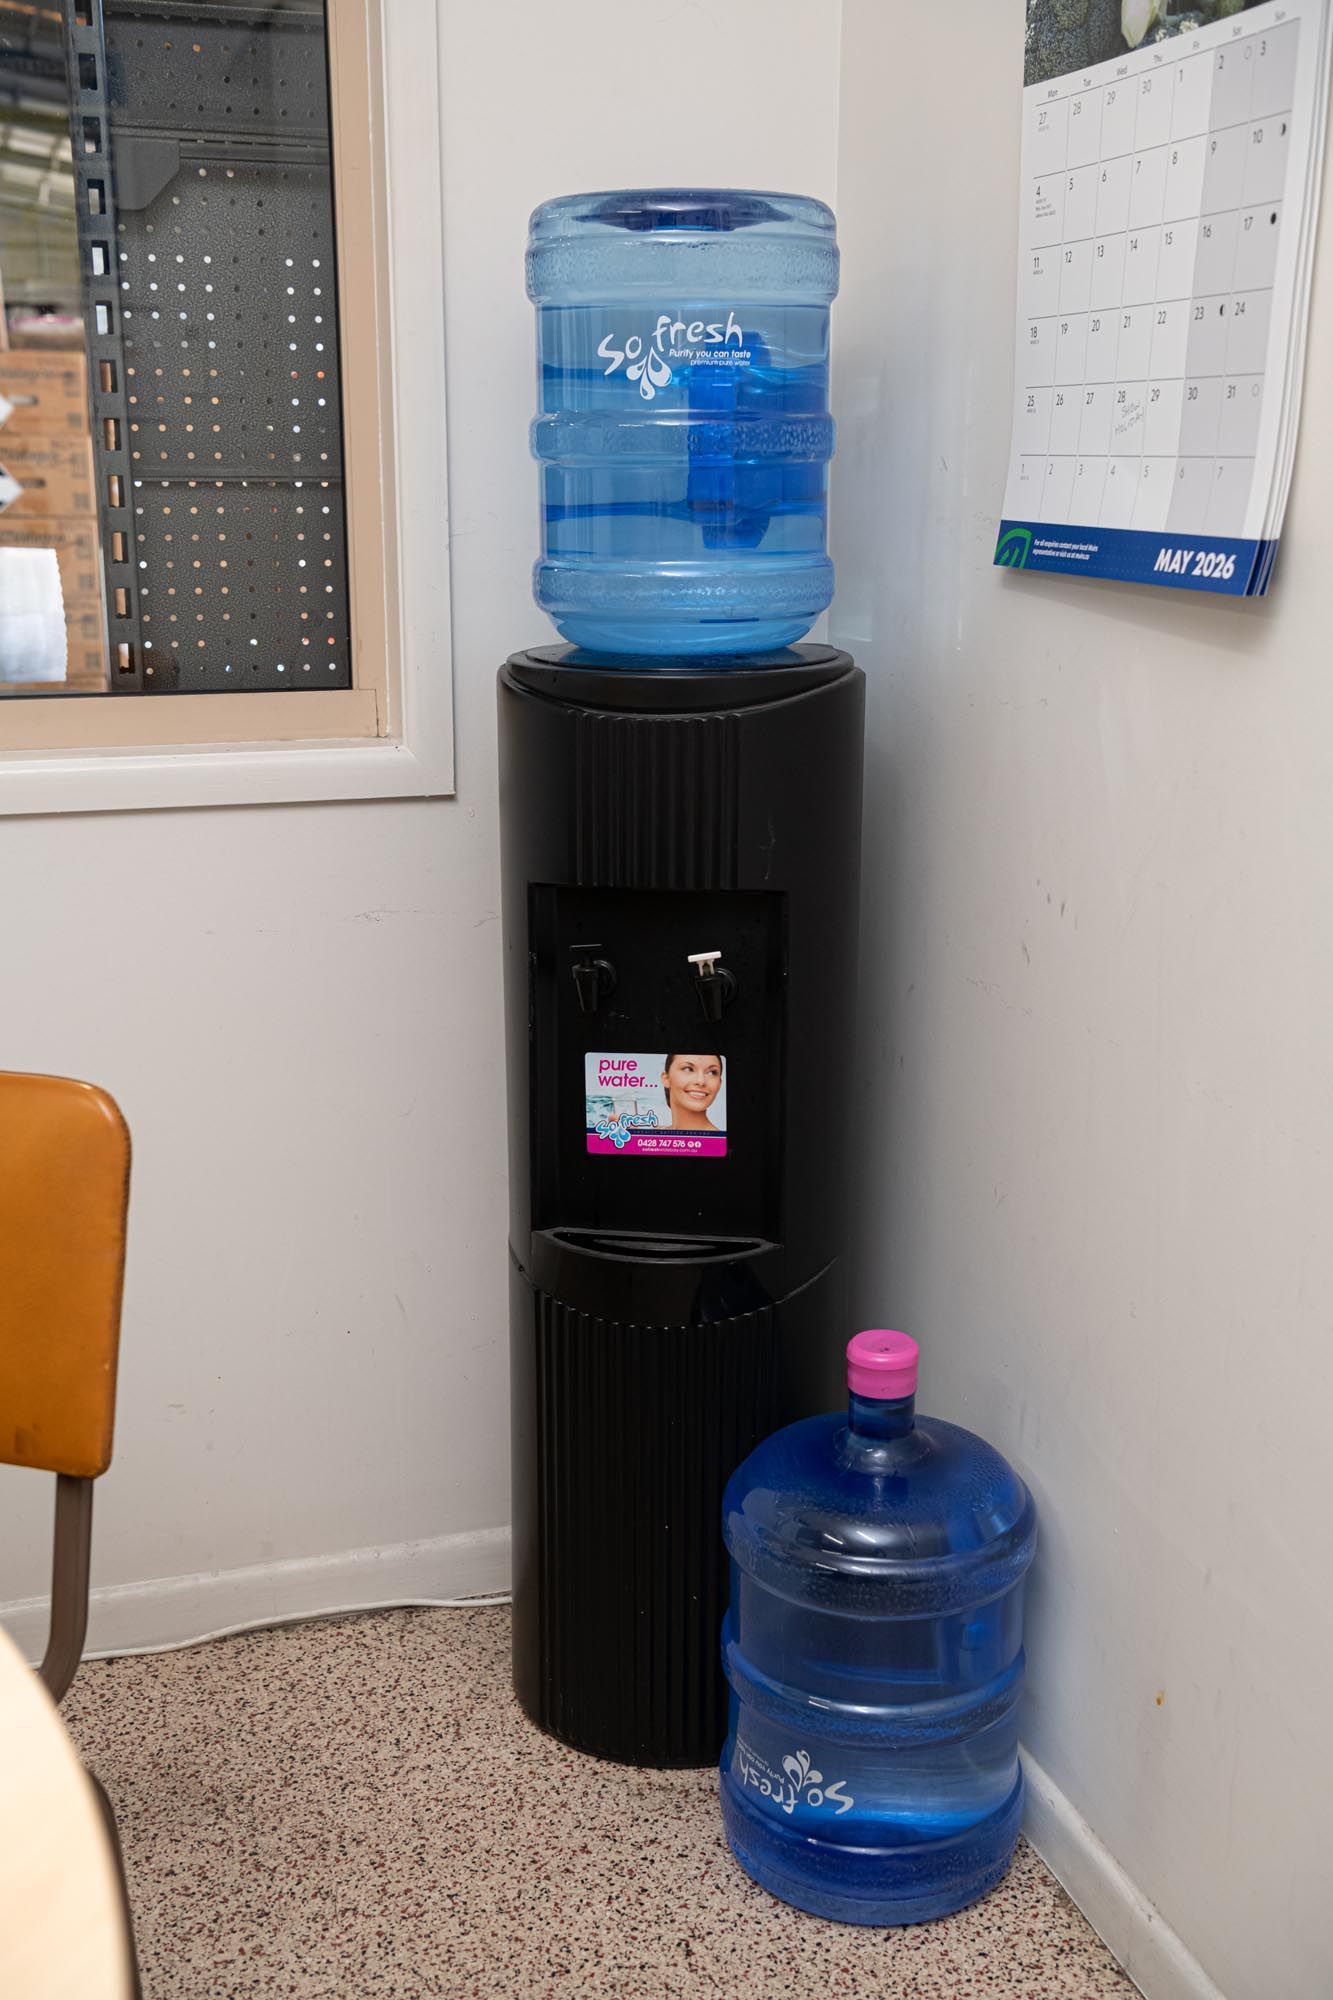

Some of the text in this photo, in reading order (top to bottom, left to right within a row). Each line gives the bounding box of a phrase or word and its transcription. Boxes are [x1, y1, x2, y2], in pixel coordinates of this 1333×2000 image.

[1039, 111, 1047, 126] 27
[1072, 101, 1082, 116] 28
[1105, 90, 1116, 106] 29
[1141, 79, 1152, 95] 30
[1218, 53, 1225, 70] 2
[1260, 40, 1267, 57] 3
[1035, 128, 1264, 198] 4 5 6 7 8 9 10
[1033, 216, 1254, 269] 11 12 13 14 15 16 17
[651, 311, 743, 352] fresh
[1030, 301, 1246, 339] 18 19 20 21 22 23 24
[669, 349, 752, 359] Purity you can taste
[690, 359, 718, 367] premium
[1027, 385, 1237, 408] 25 26 27 28 29 30 31
[1048, 463, 1054, 477] 2
[1078, 463, 1084, 477] 3
[1110, 464, 1116, 478] 4
[1143, 464, 1150, 479] 5
[1179, 466, 1185, 480] 6
[1217, 466, 1223, 480] 7
[1153, 548, 1237, 580] MAY 2026
[598, 1058, 638, 1074] pure
[598, 1073, 659, 1088] water...
[618, 1109, 659, 1128] fresh
[637, 1138, 686, 1149] 0428 747 576
[739, 1752, 799, 1815] fresh
